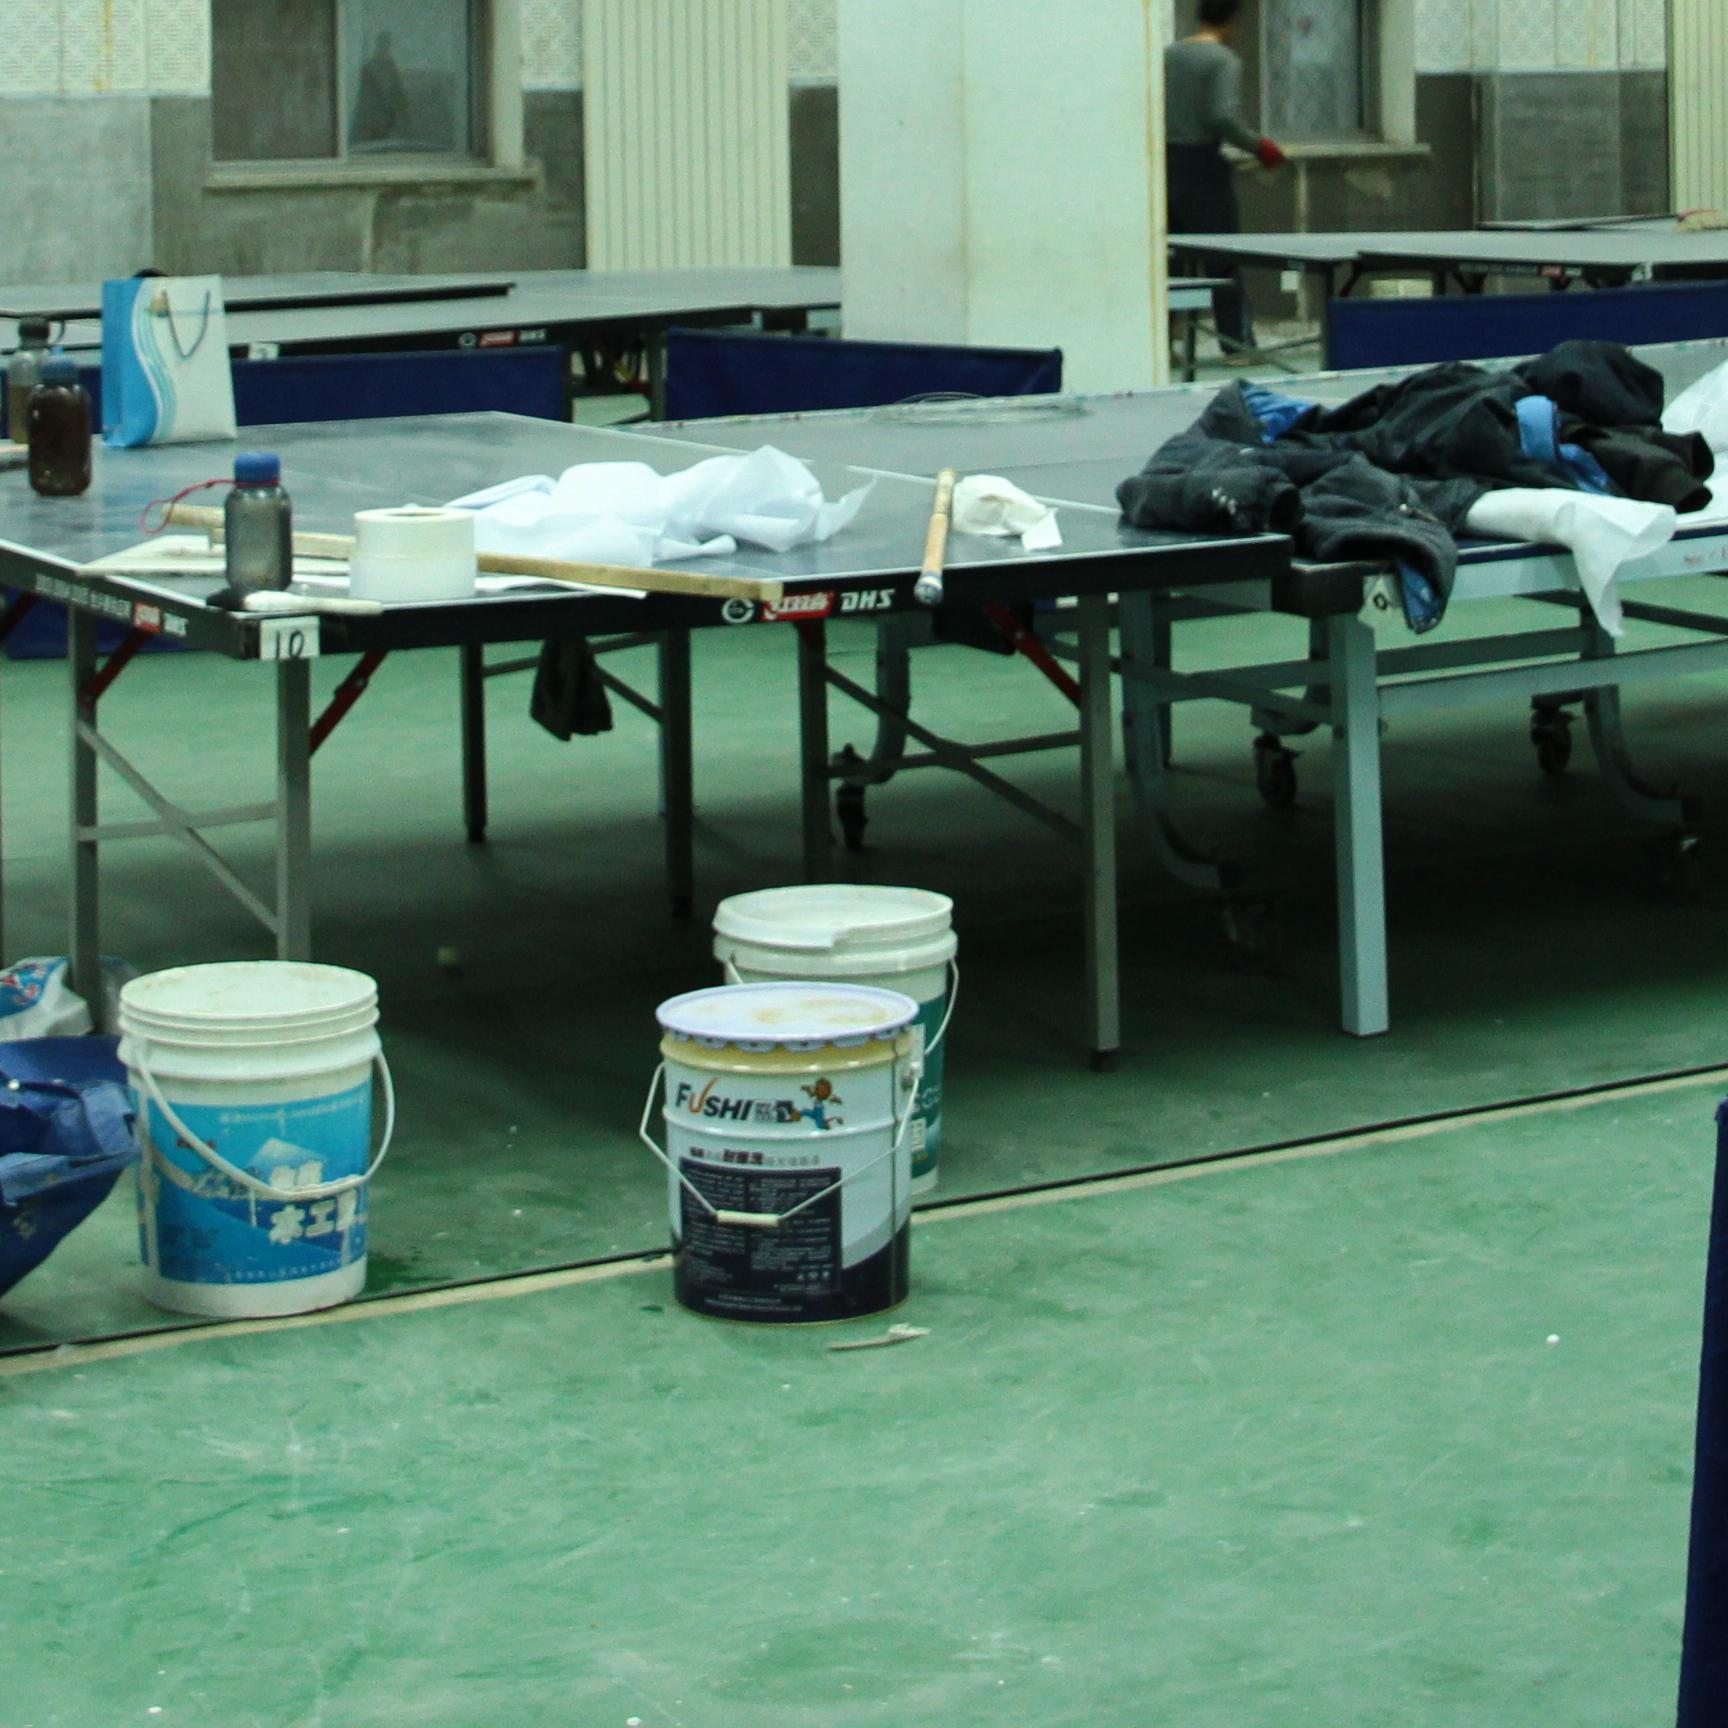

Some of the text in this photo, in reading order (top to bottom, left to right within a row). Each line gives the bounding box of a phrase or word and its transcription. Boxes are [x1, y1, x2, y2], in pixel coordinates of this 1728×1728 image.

[839, 587, 896, 613] DHS
[274, 629, 305, 660] 10
[674, 1076, 754, 1122] FUSHI
